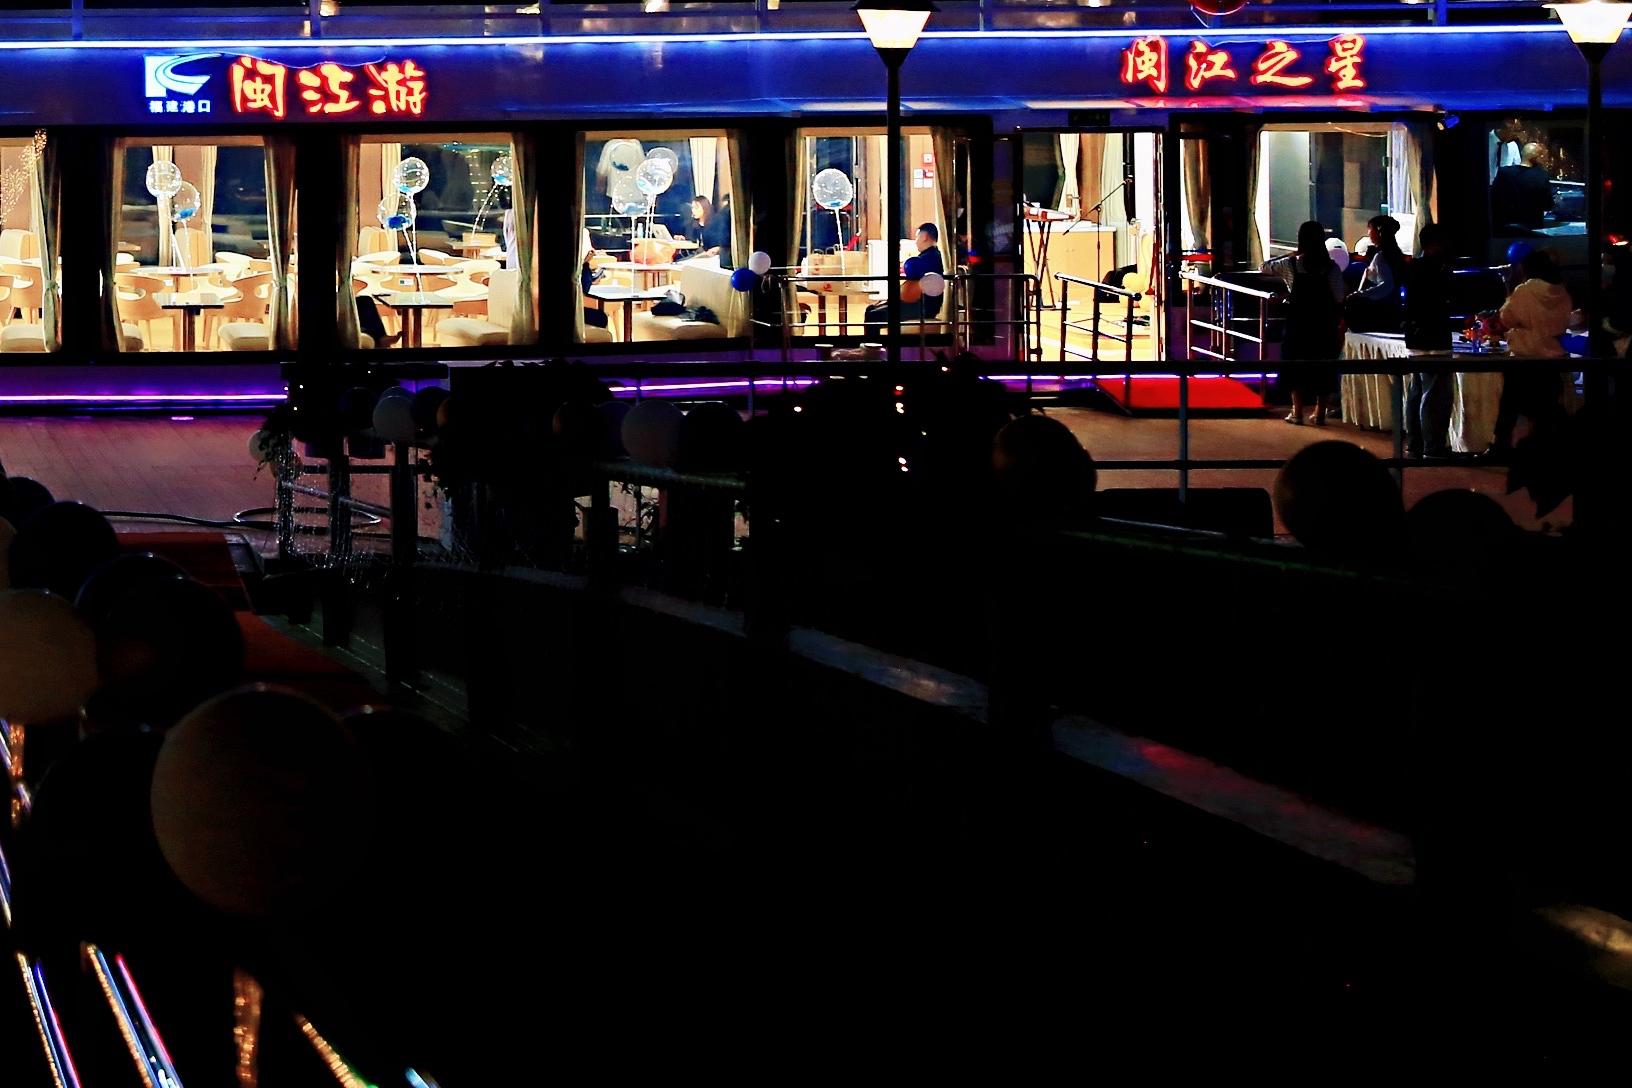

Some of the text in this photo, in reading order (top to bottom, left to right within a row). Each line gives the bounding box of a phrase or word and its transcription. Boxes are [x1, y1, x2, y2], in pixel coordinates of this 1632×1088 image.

[229, 56, 426, 119] 闽江游
[1121, 34, 1366, 93] 闽江之星
